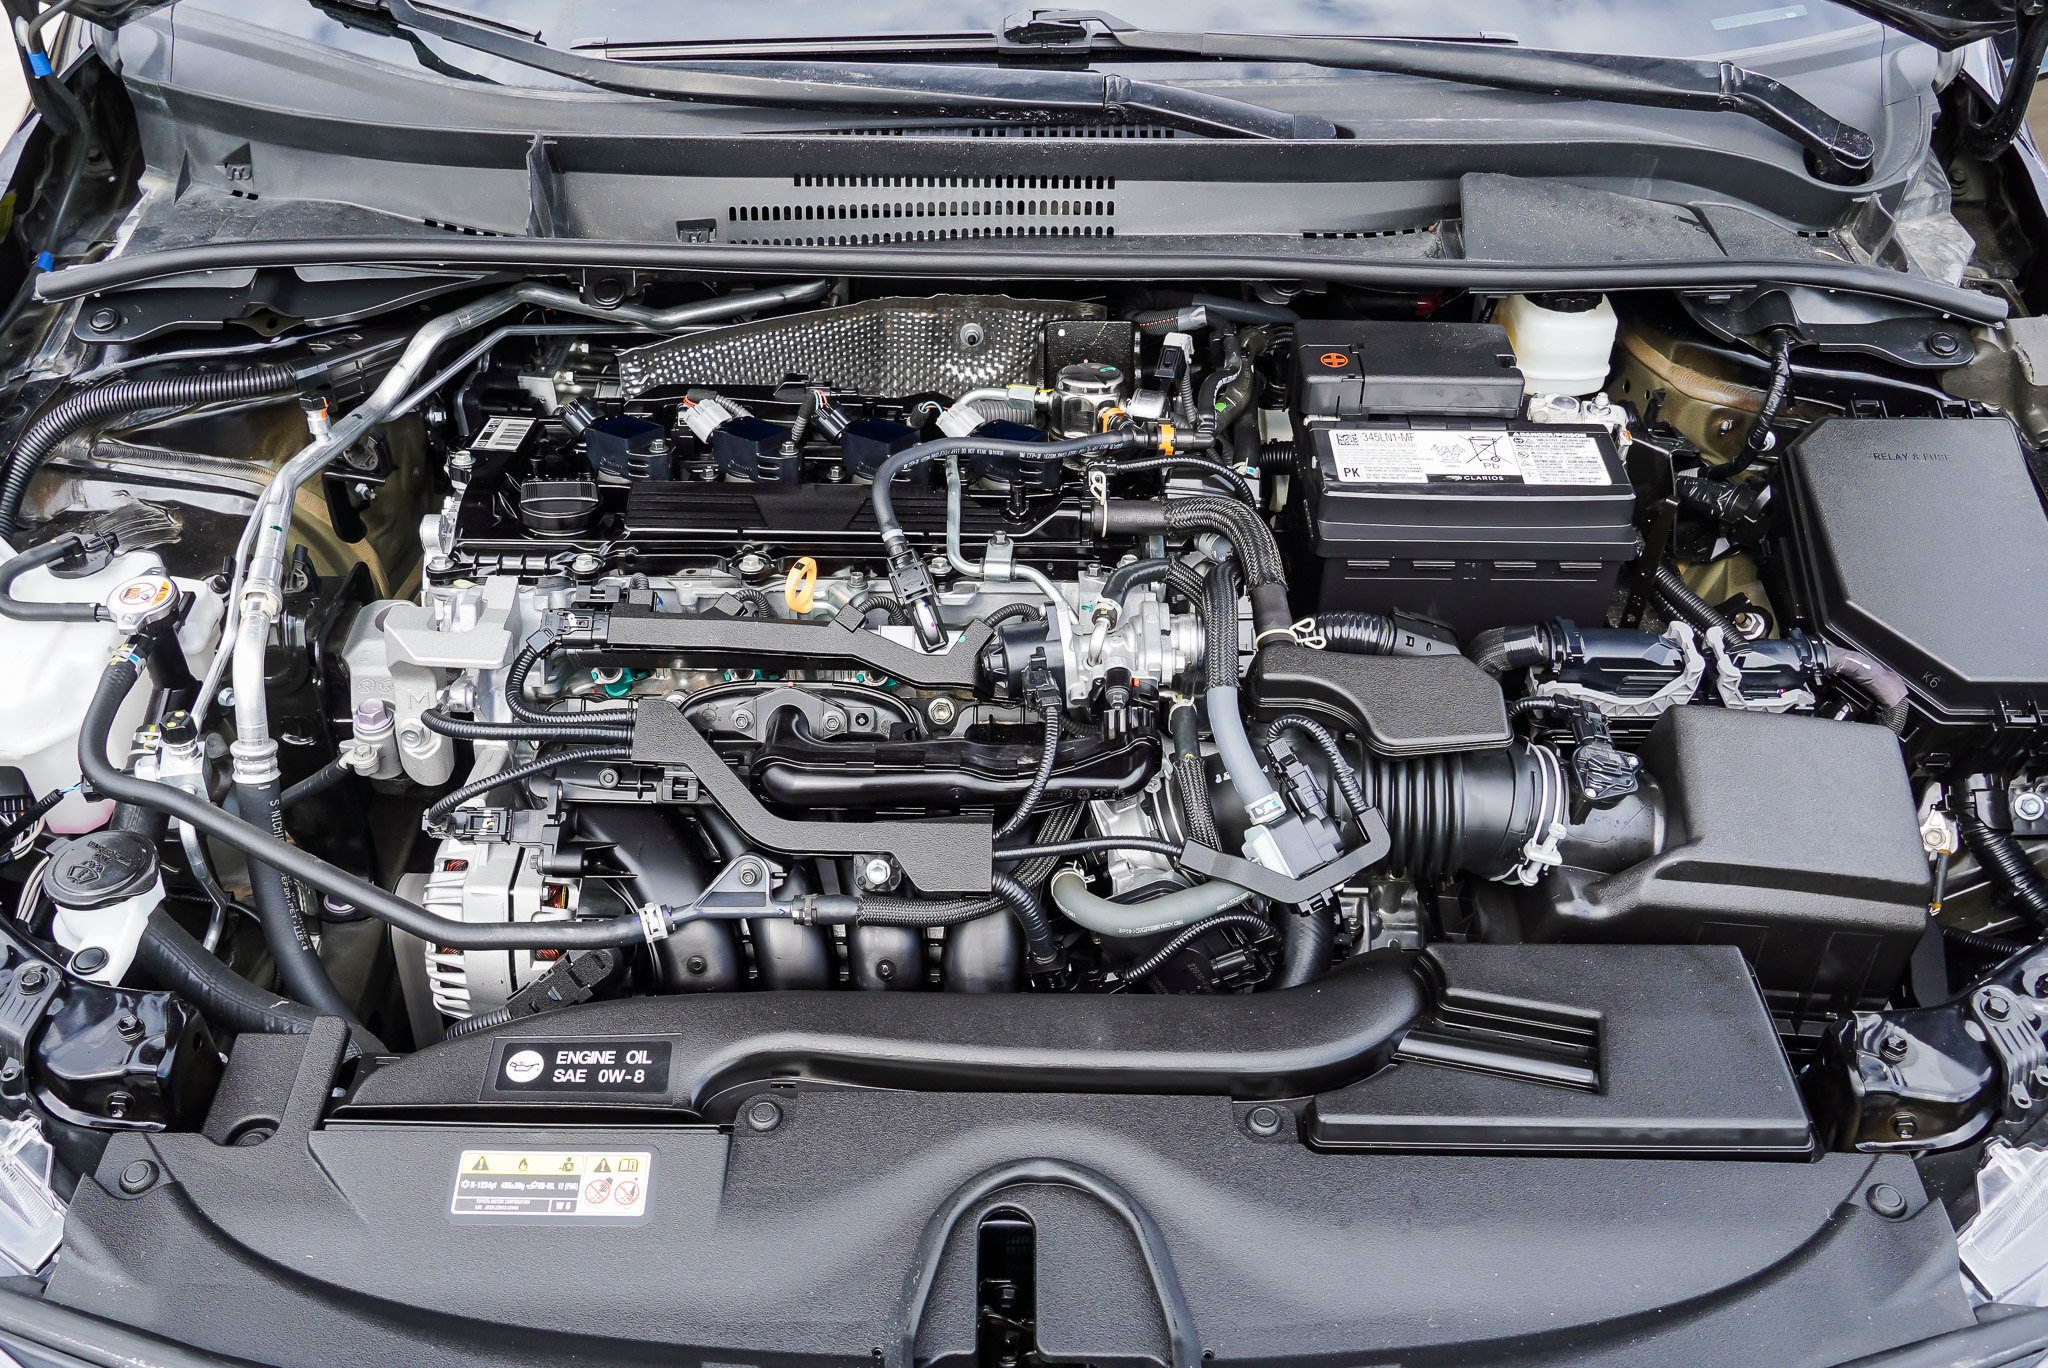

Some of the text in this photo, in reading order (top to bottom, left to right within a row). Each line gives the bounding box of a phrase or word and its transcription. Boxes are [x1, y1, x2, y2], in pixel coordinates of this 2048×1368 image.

[1361, 432, 1415, 442] 345LN1-MF
[1873, 452, 1908, 461] RELAY
[1482, 462, 1500, 470] Pb
[1343, 467, 1361, 478] PK
[556, 1050, 653, 1065] ENGINE OIL
[552, 1068, 646, 1084] SAE 0W-8
